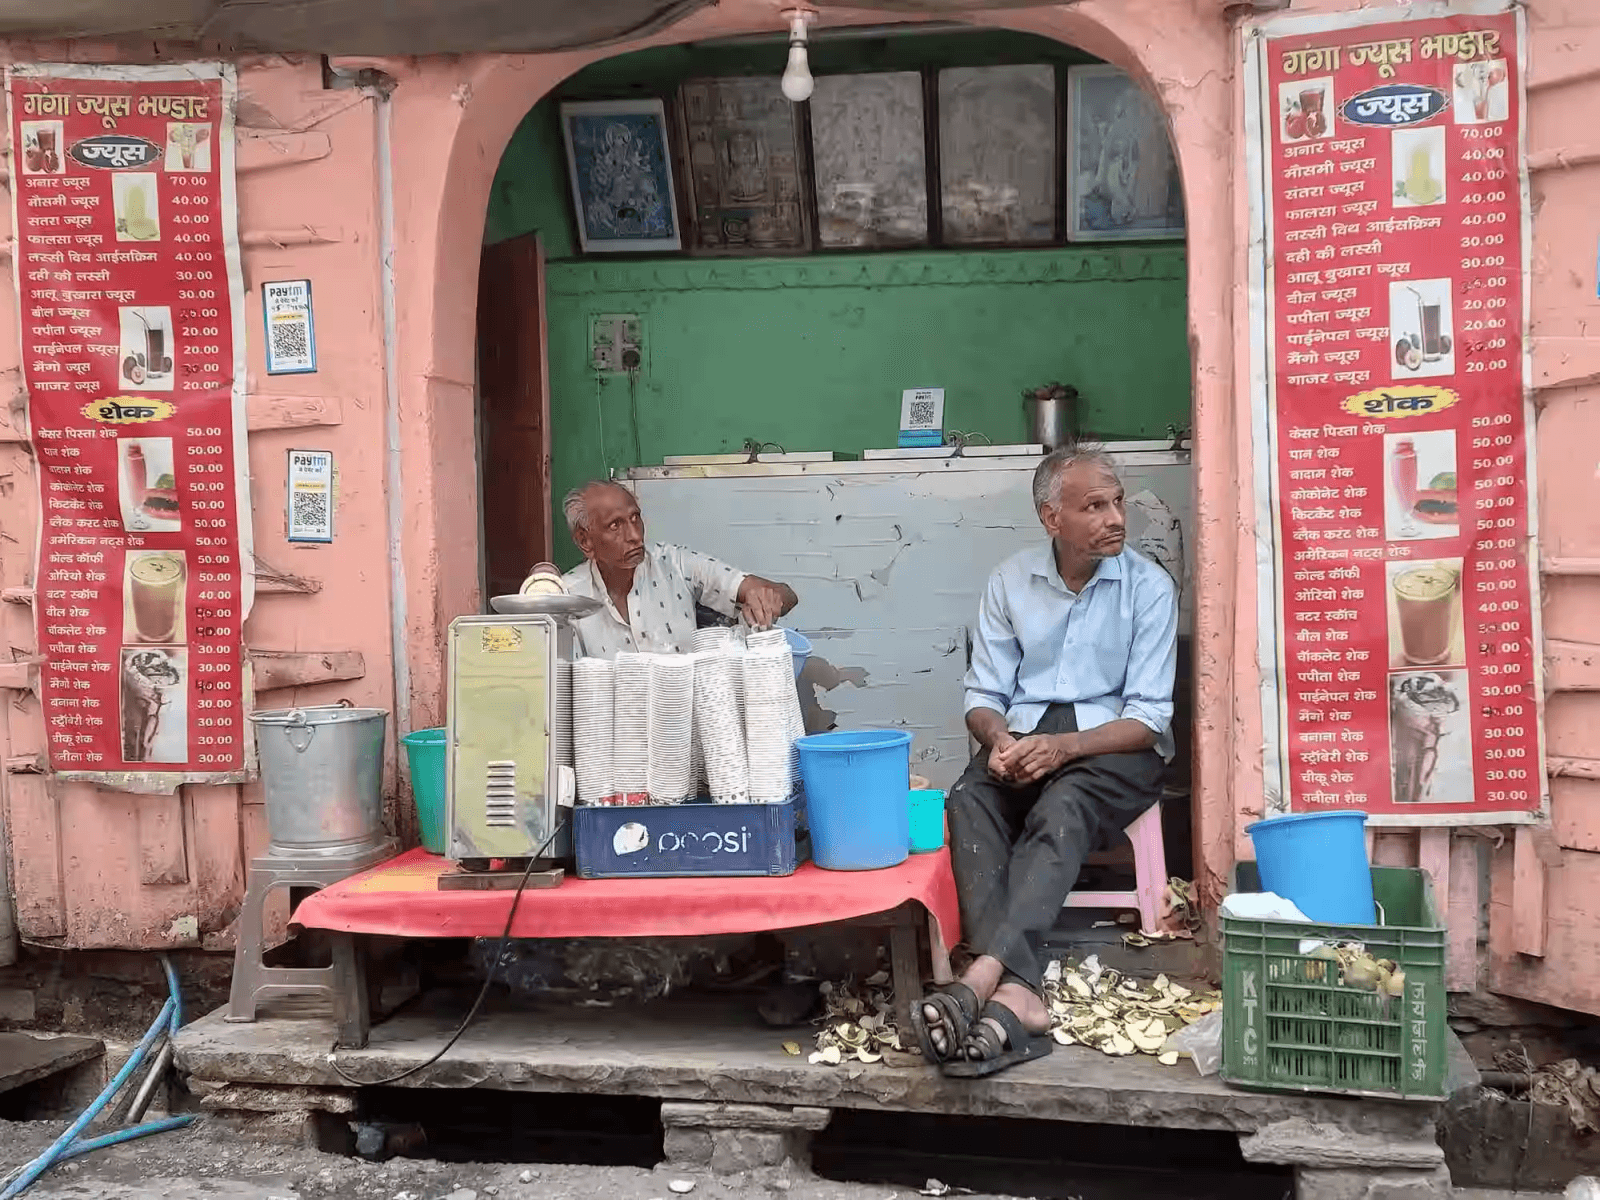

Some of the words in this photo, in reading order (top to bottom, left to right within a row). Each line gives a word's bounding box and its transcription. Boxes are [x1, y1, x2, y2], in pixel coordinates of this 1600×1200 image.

[1282, 42, 1341, 75] गंगा
[1349, 38, 1412, 78] ज्यूस
[1420, 29, 1500, 60] भण्डार
[23, 86, 70, 116] गंगा
[76, 95, 132, 128] ज्यूस
[138, 96, 210, 119] भण्डार
[1355, 93, 1431, 121] ज्यूस
[1460, 126, 1502, 139] 70.00
[81, 144, 148, 166] ज्यूस
[1460, 148, 1504, 161] 40.00
[170, 177, 206, 185] 70.00
[1461, 170, 1504, 182] 40.00
[171, 196, 208, 205] 40.00
[1461, 191, 1505, 204] 40.00
[173, 215, 209, 223] 40.00
[1461, 213, 1506, 225] 40.00
[174, 234, 210, 243] 40.00
[1460, 234, 1504, 247] 30.00
[175, 252, 212, 261] 40.00
[1461, 256, 1504, 268] 30.00
[176, 271, 212, 280] 30.00
[1462, 298, 1506, 310] 20.00
[1463, 319, 1505, 331] 20.00
[182, 328, 218, 336] 20.00
[183, 346, 219, 354] 20.00
[1465, 360, 1507, 372] 20.00
[1364, 394, 1437, 413] शेक
[100, 402, 158, 419] शेक
[1363, 424, 1385, 435] शेक
[1472, 414, 1511, 427] 50.00
[100, 427, 118, 438] शेक
[187, 428, 221, 436] 50.00
[188, 446, 222, 454] 50.00
[1317, 447, 1340, 458] शेक
[1472, 435, 1512, 448] 50.00
[189, 464, 223, 473] 50.00
[1330, 467, 1354, 478] शेक
[1473, 455, 1513, 469] 50.00
[190, 483, 224, 491] 50.00
[1344, 486, 1367, 498] शेक
[1475, 476, 1514, 490] 50.00
[191, 501, 224, 509] 50.00
[1338, 507, 1361, 518] शेक
[1475, 497, 1514, 510] 50.00
[194, 519, 226, 527] 50.00
[1356, 527, 1379, 538] शेक
[1476, 518, 1515, 530] 50.00
[196, 537, 227, 546] 50.00
[1476, 539, 1515, 551] 50.00
[198, 555, 229, 564] 50.00
[1476, 559, 1516, 571] 50.00
[199, 573, 231, 581] 50.00
[199, 591, 231, 599] 40.00
[1341, 586, 1364, 599] शेक
[1476, 579, 1516, 592] 50.00
[1478, 601, 1519, 613] 40.00
[1325, 628, 1348, 641] शेक
[198, 645, 230, 654] 30.00
[1345, 649, 1369, 661] शेक
[198, 664, 230, 672] 30.00
[1337, 670, 1360, 681] शेक
[1480, 663, 1520, 675] 30.00
[1354, 689, 1377, 701] शेक
[1482, 685, 1521, 696] 30.00
[197, 699, 232, 708] 30.00
[1329, 709, 1351, 721] शेक
[198, 718, 232, 726] 30.00
[198, 736, 232, 744] 30.00
[1341, 730, 1363, 741] शेक
[1484, 727, 1523, 738] 30.00
[199, 754, 232, 762] 30.00
[1344, 750, 1368, 761] शेक
[1485, 748, 1524, 760] 30.00
[1330, 771, 1354, 782] शेक
[1486, 770, 1526, 780] 30.00
[1344, 791, 1367, 802] शेक
[1487, 791, 1527, 801] 30.00
